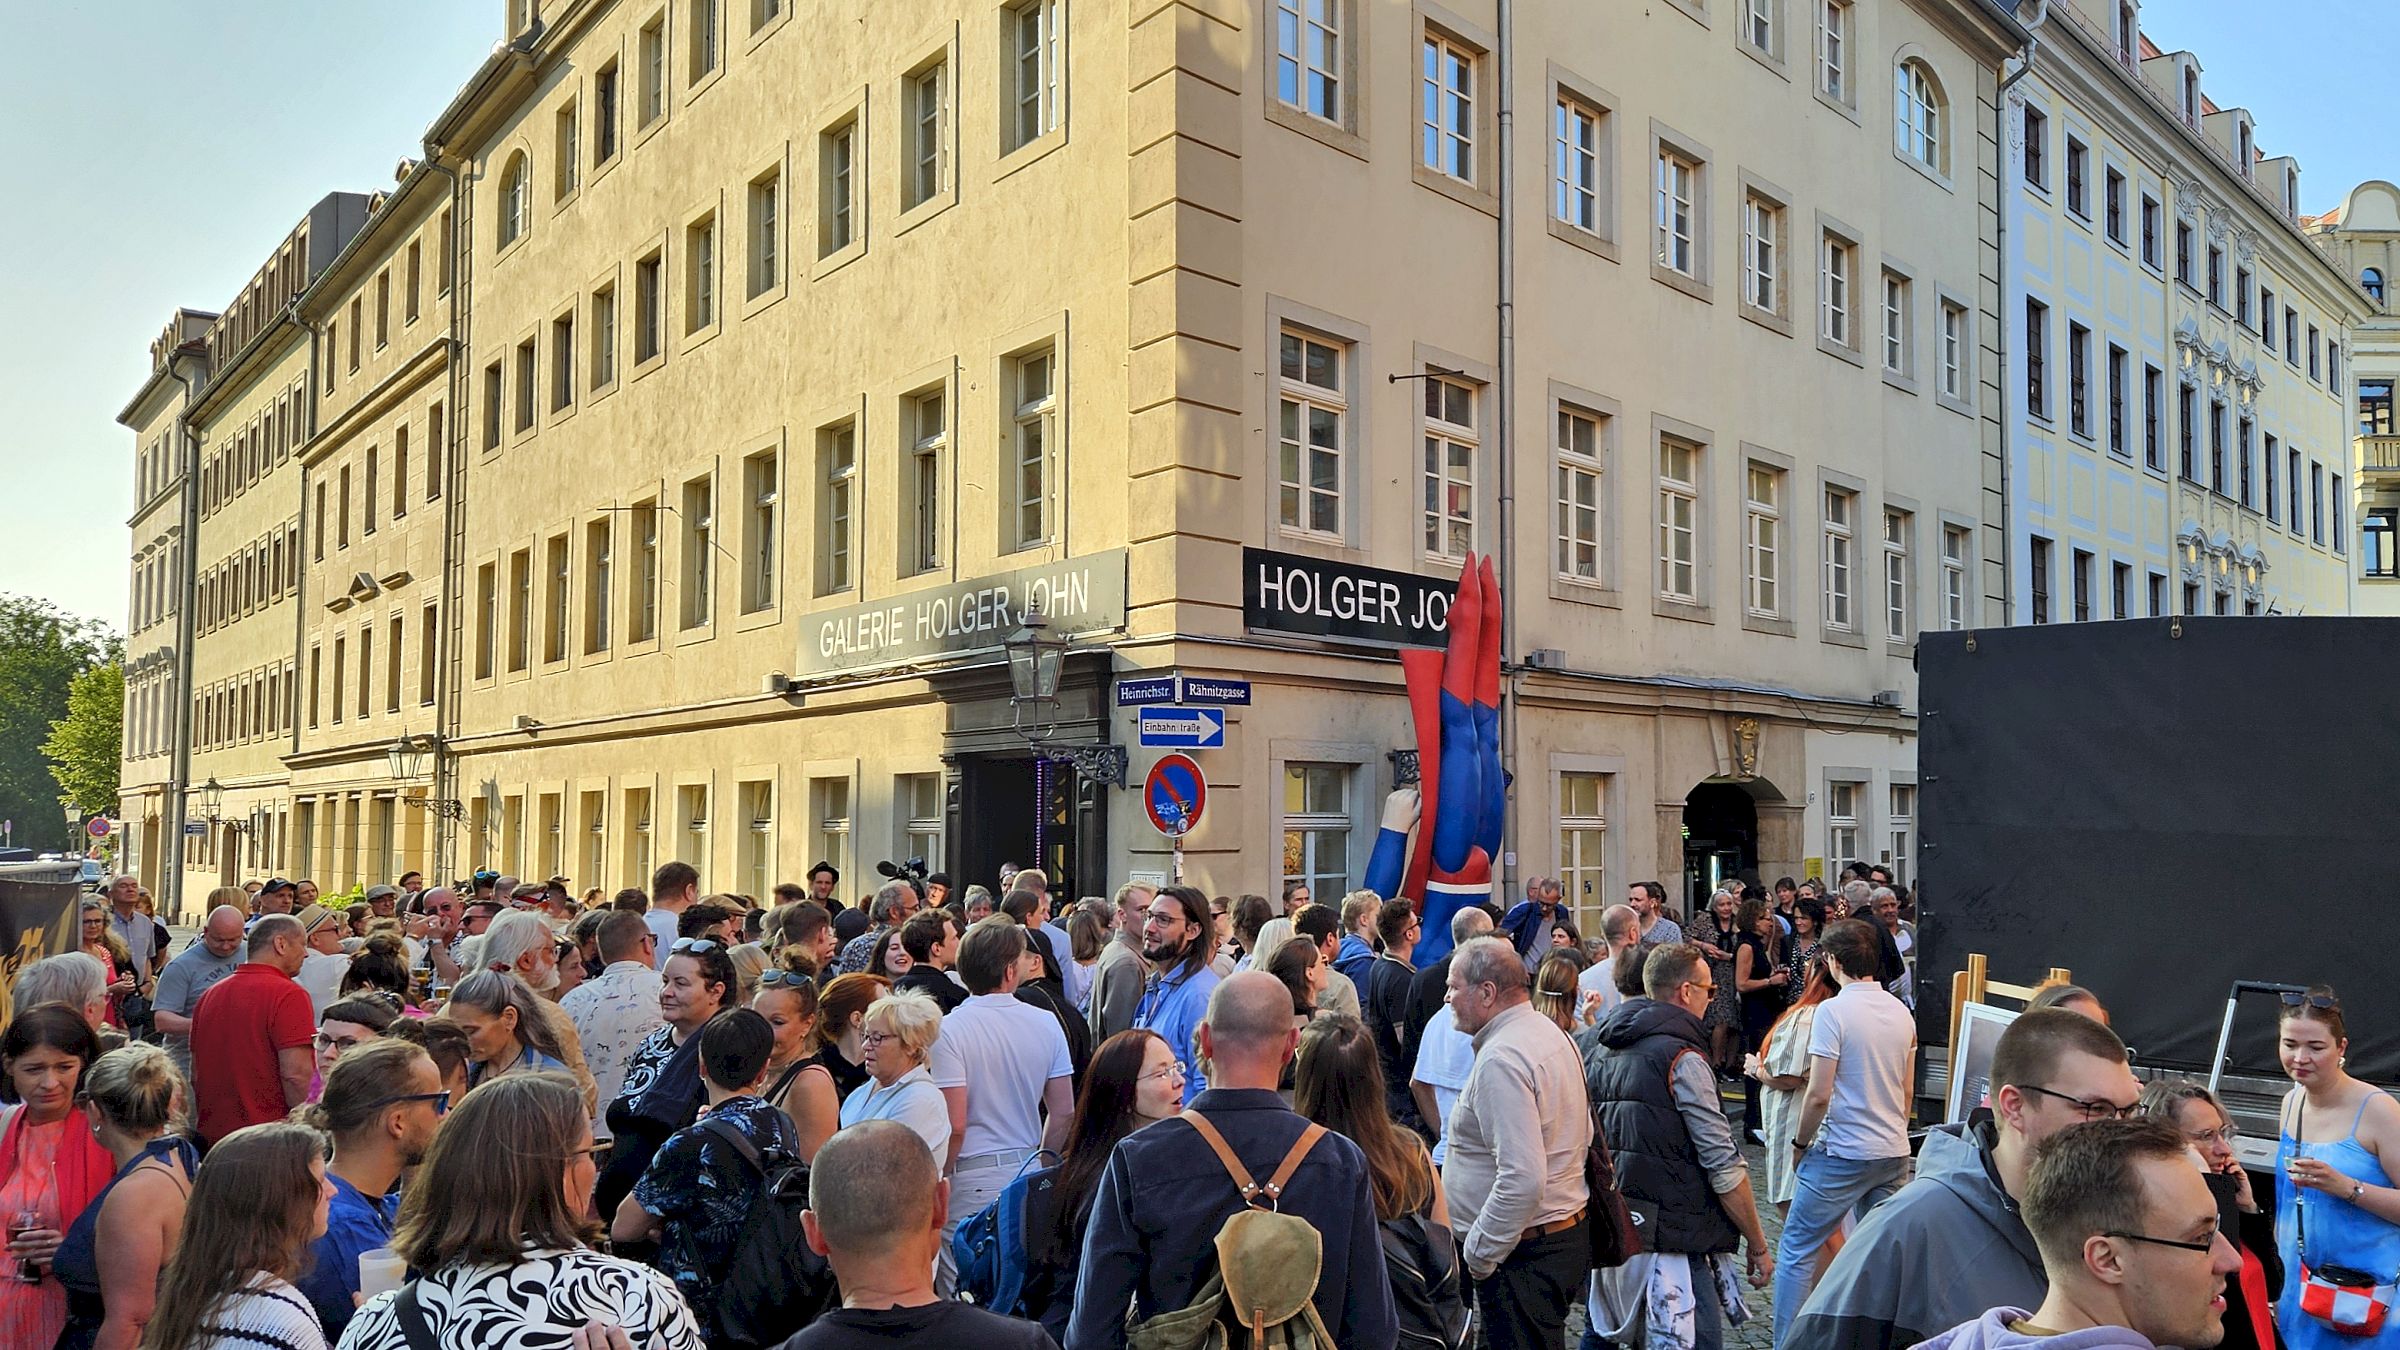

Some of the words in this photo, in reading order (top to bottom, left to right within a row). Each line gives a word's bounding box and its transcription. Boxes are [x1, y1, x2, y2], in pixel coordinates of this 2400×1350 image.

[1259, 563, 1403, 626] HOLGER
[1410, 588, 1456, 632] JO
[819, 606, 905, 658] GALERIE
[915, 585, 1011, 642] HOLGER
[1016, 568, 1089, 626] JOHN
[1120, 684, 1171, 700] Heinrichstr.
[1188, 682, 1246, 700] Rähnitzgasse
[1144, 722, 1201, 733] Einbahntraße
